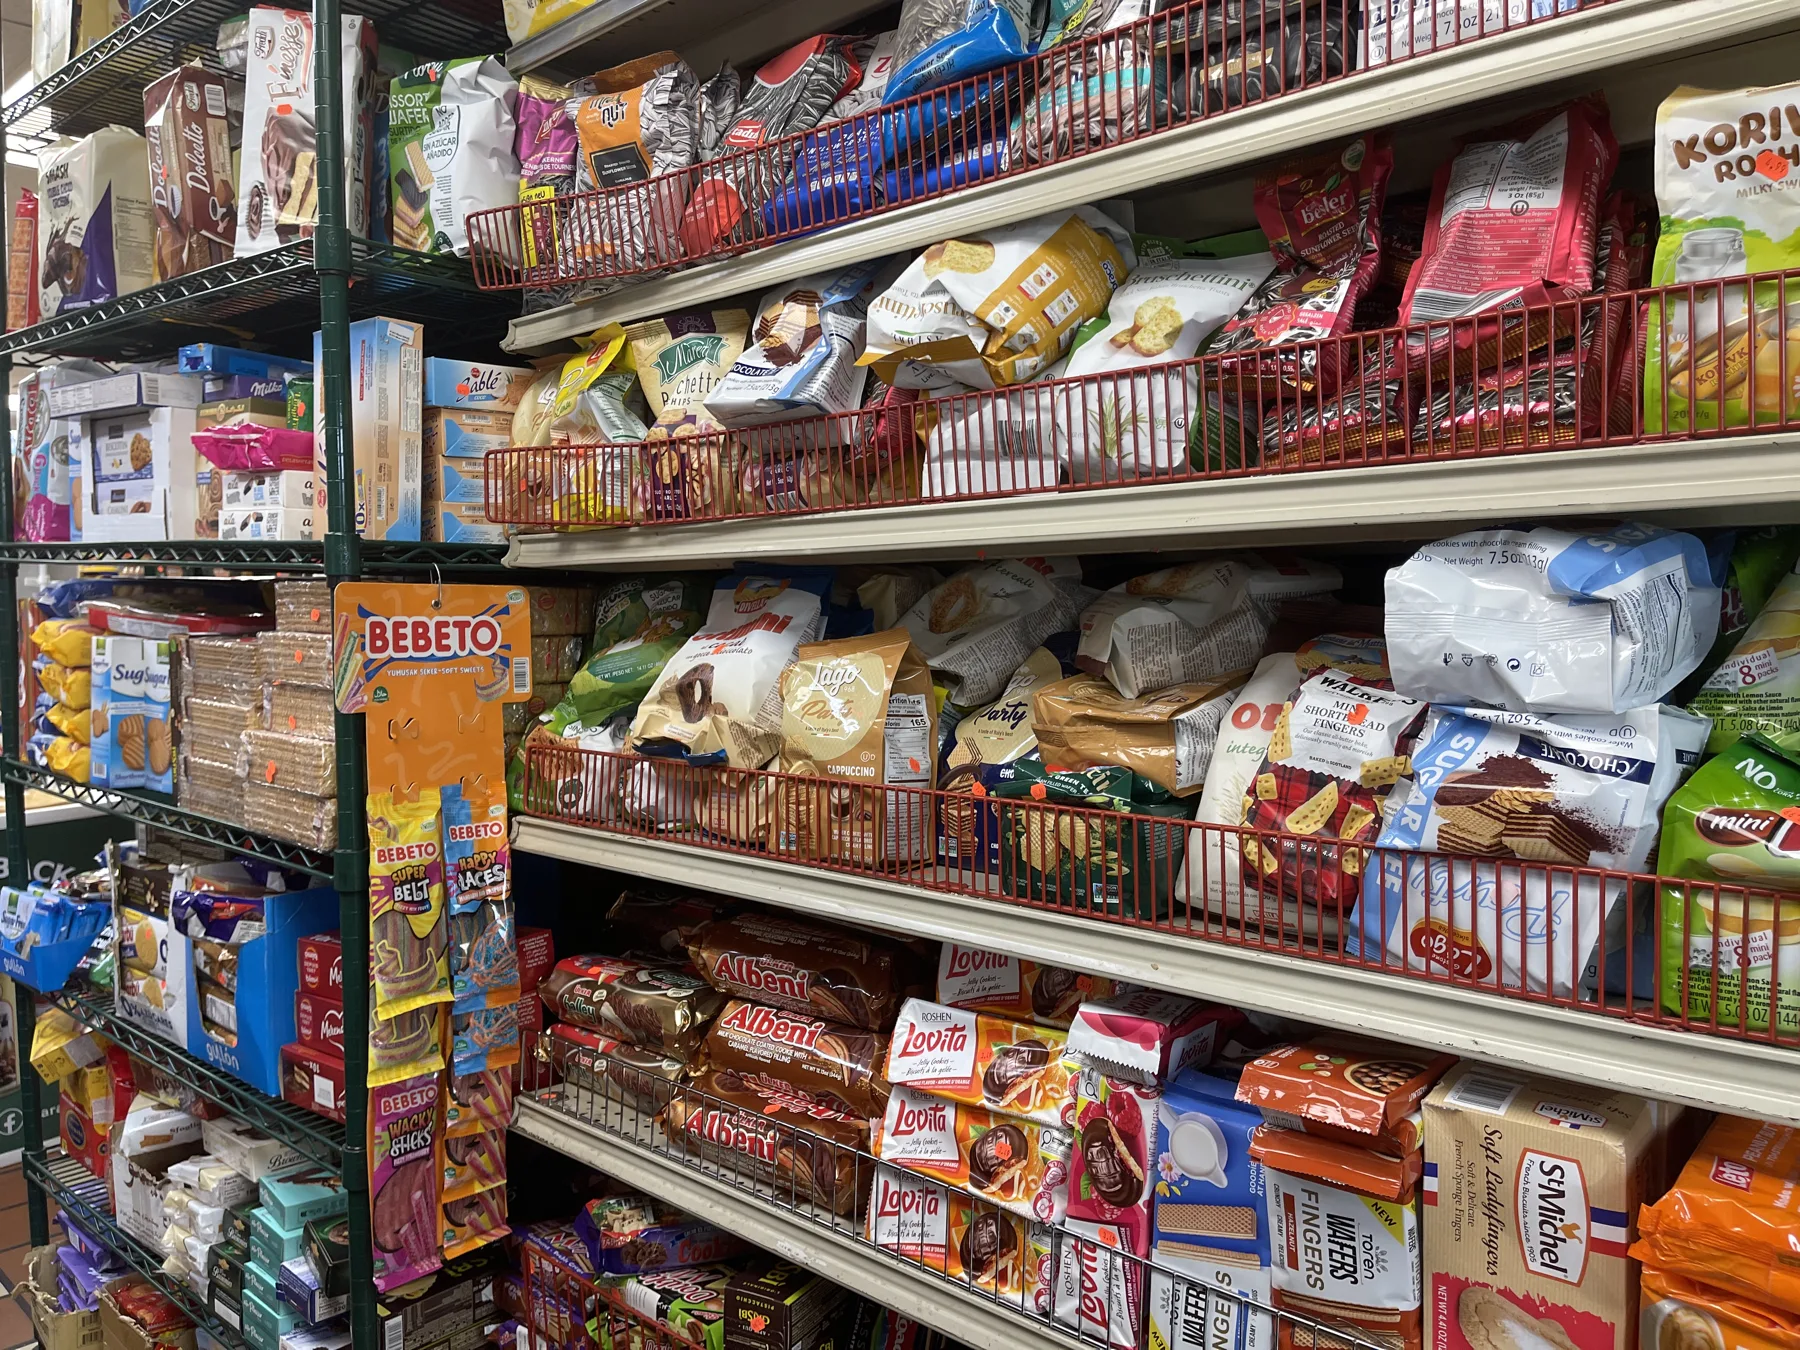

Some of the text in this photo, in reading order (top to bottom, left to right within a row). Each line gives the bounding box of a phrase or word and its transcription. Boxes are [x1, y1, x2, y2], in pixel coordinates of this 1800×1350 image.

[188, 120, 211, 194] Dolcetto
[1735, 182, 1774, 200] MILKY
[1301, 191, 1348, 225] besler
[1300, 232, 1342, 258] SUNFLOWER
[1432, 540, 1548, 554] cookies with filling
[1443, 557, 1457, 565] Net
[1458, 556, 1484, 568] Weight
[366, 616, 501, 657] BEBETO
[809, 661, 862, 696] Lago
[1739, 664, 1757, 685] 8
[1754, 660, 1772, 671] mini
[1757, 666, 1779, 680] packs
[910, 718, 927, 727] 165
[1313, 717, 1366, 739] FINGERS
[1729, 719, 1754, 731] 5.08
[1295, 733, 1374, 758] deliciously crumbly and moreish
[827, 765, 875, 777] CAPPUCCINO
[1309, 755, 1352, 770] BAKED SCOTLAND
[1734, 757, 1778, 790] NO
[1054, 774, 1080, 786] GREEN
[450, 822, 503, 841] BEBETO
[1709, 813, 1775, 832] mini
[377, 841, 438, 864] BEBETO
[391, 865, 426, 885] SUPER
[458, 864, 506, 891] LACES
[394, 878, 430, 902] BELT
[1749, 943, 1770, 953] mini
[759, 954, 795, 973] ÜLKER
[712, 953, 811, 1001] Albeni
[563, 994, 597, 1025] halley
[921, 1012, 952, 1022] ROSHEN
[1752, 1007, 1768, 1023] OZ
[721, 1003, 826, 1050] Albeni
[717, 1030, 807, 1060] MILK CHOCOLATE COATED COOKIE WITH
[728, 1040, 791, 1063] CARAMEL FLAVORED FILLING
[898, 1022, 968, 1058] Lovita
[917, 1056, 950, 1068] Jelly Cookies
[938, 1065, 954, 1075] gelée
[759, 1072, 792, 1092] ÜLKER
[381, 1084, 438, 1116] BEBETO
[388, 1107, 434, 1138] WACKY
[731, 1109, 767, 1133] ÜLKER
[890, 1099, 947, 1137] Lovita
[390, 1120, 433, 1157] STICKS
[684, 1107, 780, 1166] Albeni
[1467, 1160, 1476, 1182] Soft
[877, 1179, 939, 1218] Lovita
[1451, 1140, 1465, 1243] French Sponge Fingers
[1479, 1125, 1507, 1276] Soft Ladyfingers
[1272, 1183, 1284, 1239] CRUNCHY CREAMY
[1370, 1201, 1397, 1228] NEW
[1467, 1191, 1477, 1228] Delicate
[1521, 1158, 1537, 1263] French Biscuits since 1905
[1286, 1212, 1296, 1254] HAZELNUT
[1301, 1187, 1325, 1291] FINGERS
[1326, 1212, 1359, 1285] WAFERS
[1063, 1250, 1074, 1298] ROSHEN
[1128, 1302, 1138, 1332] RASPBERRY
[1437, 1284, 1448, 1342] NET WT OZ
